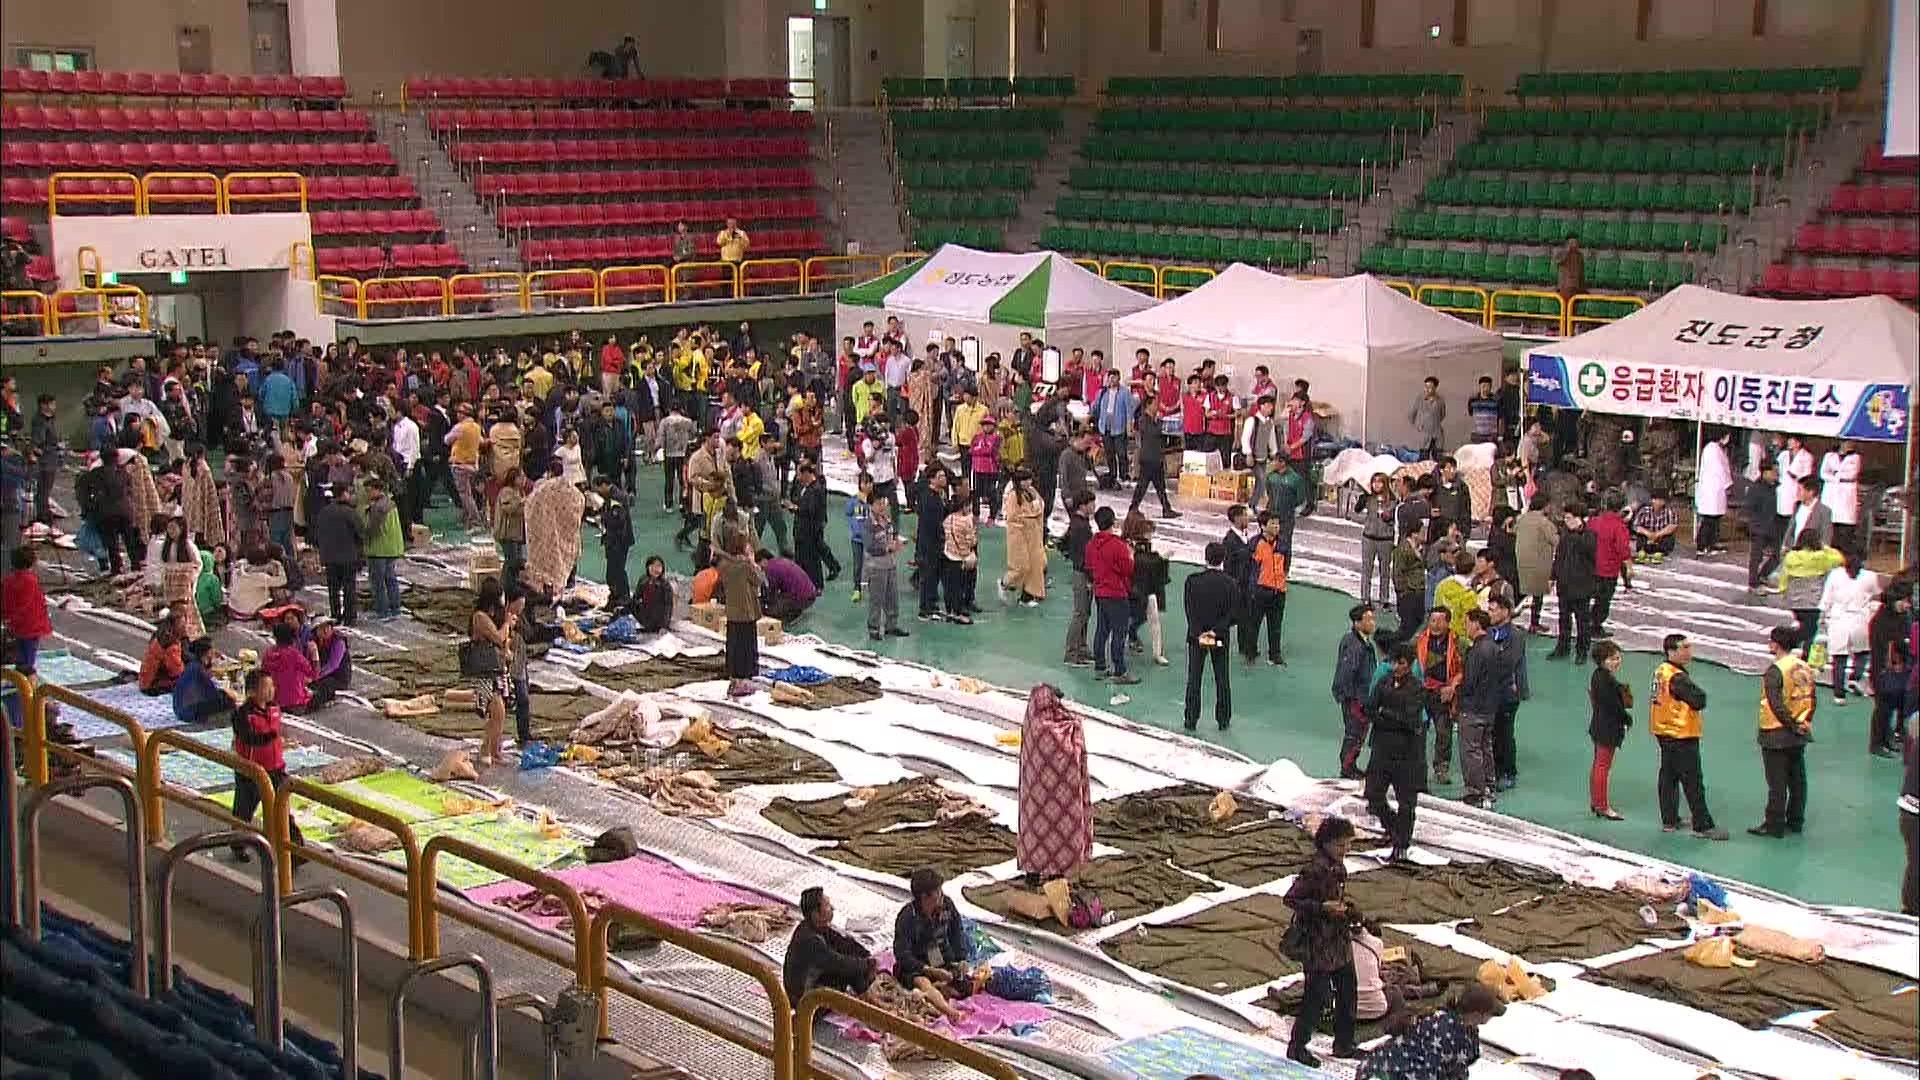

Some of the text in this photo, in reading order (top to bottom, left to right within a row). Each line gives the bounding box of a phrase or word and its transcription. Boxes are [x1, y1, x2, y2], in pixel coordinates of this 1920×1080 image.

[1675, 319, 1825, 349] 진도군청
[1611, 366, 1705, 407] 응급환자
[1714, 373, 1841, 418] 이동진료소
